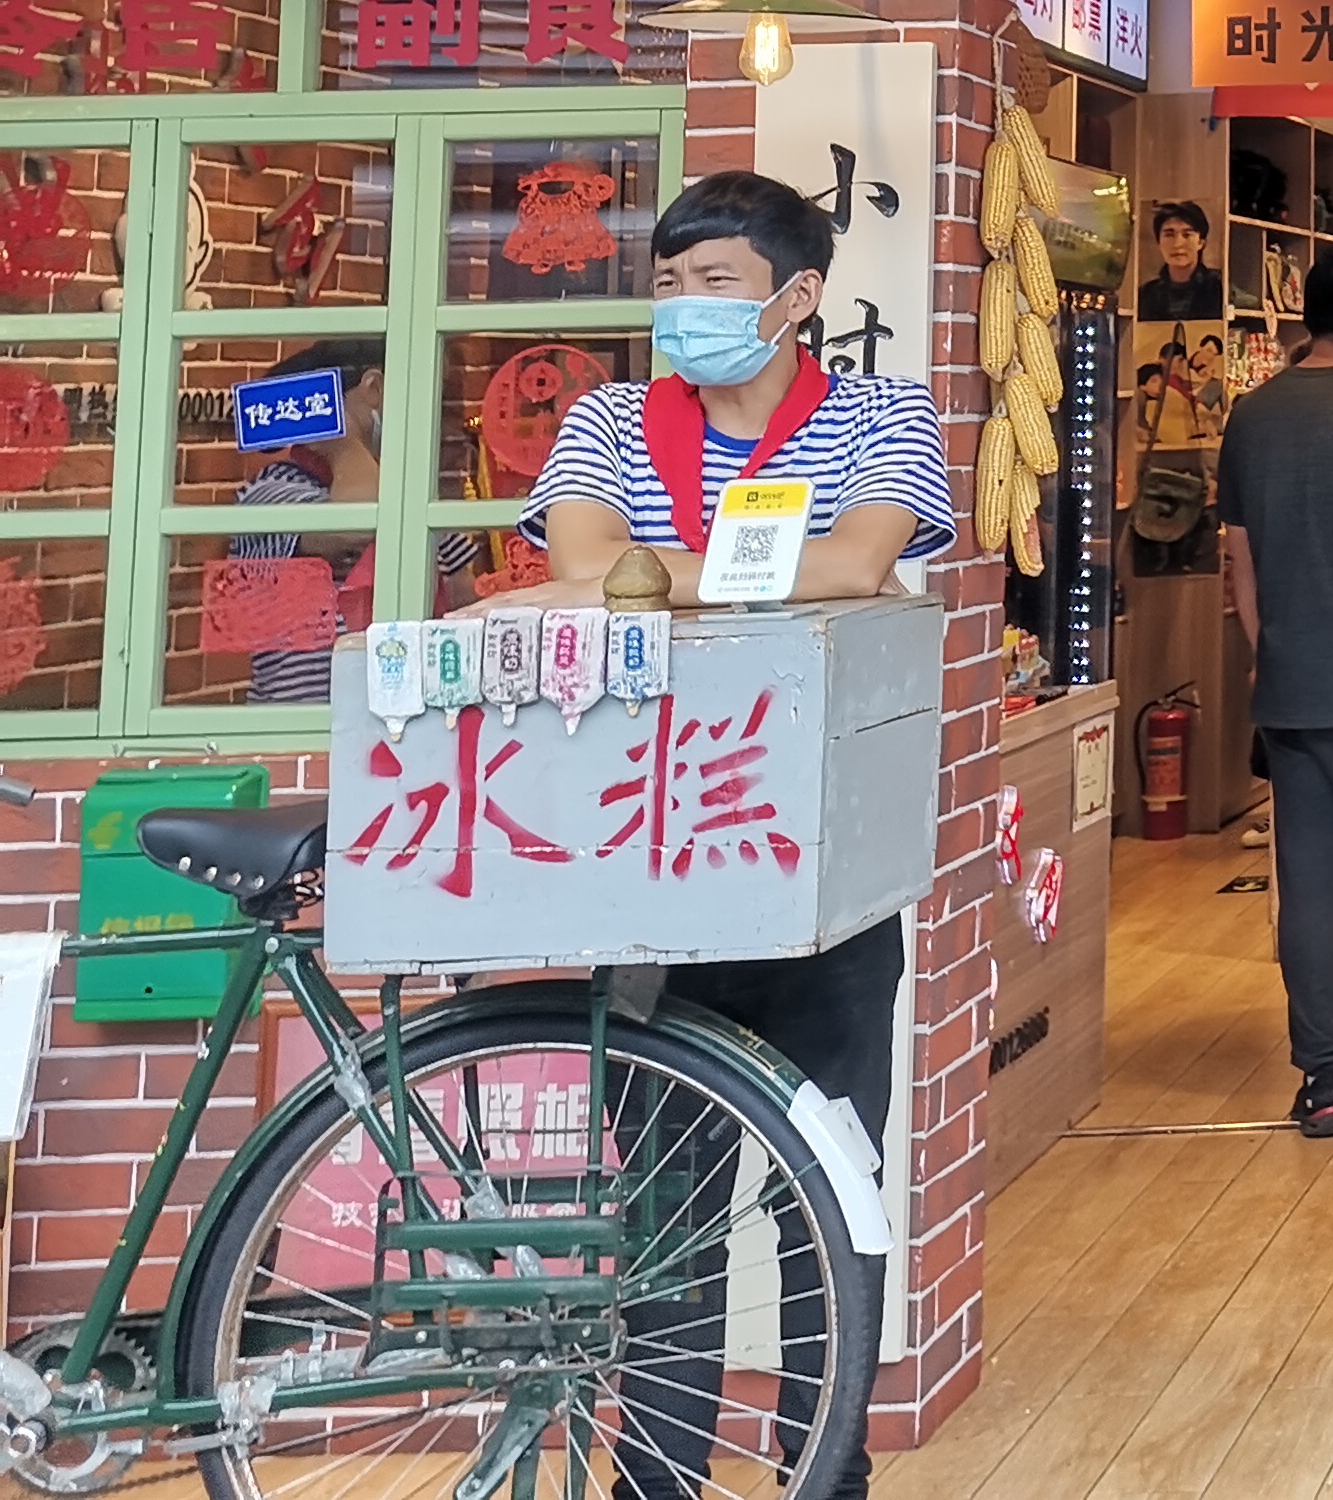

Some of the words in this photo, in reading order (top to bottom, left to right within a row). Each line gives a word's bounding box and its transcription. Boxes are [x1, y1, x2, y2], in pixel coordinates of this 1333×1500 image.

[245, 392, 333, 429] 传达室
[342, 687, 801, 898] 冰糕
